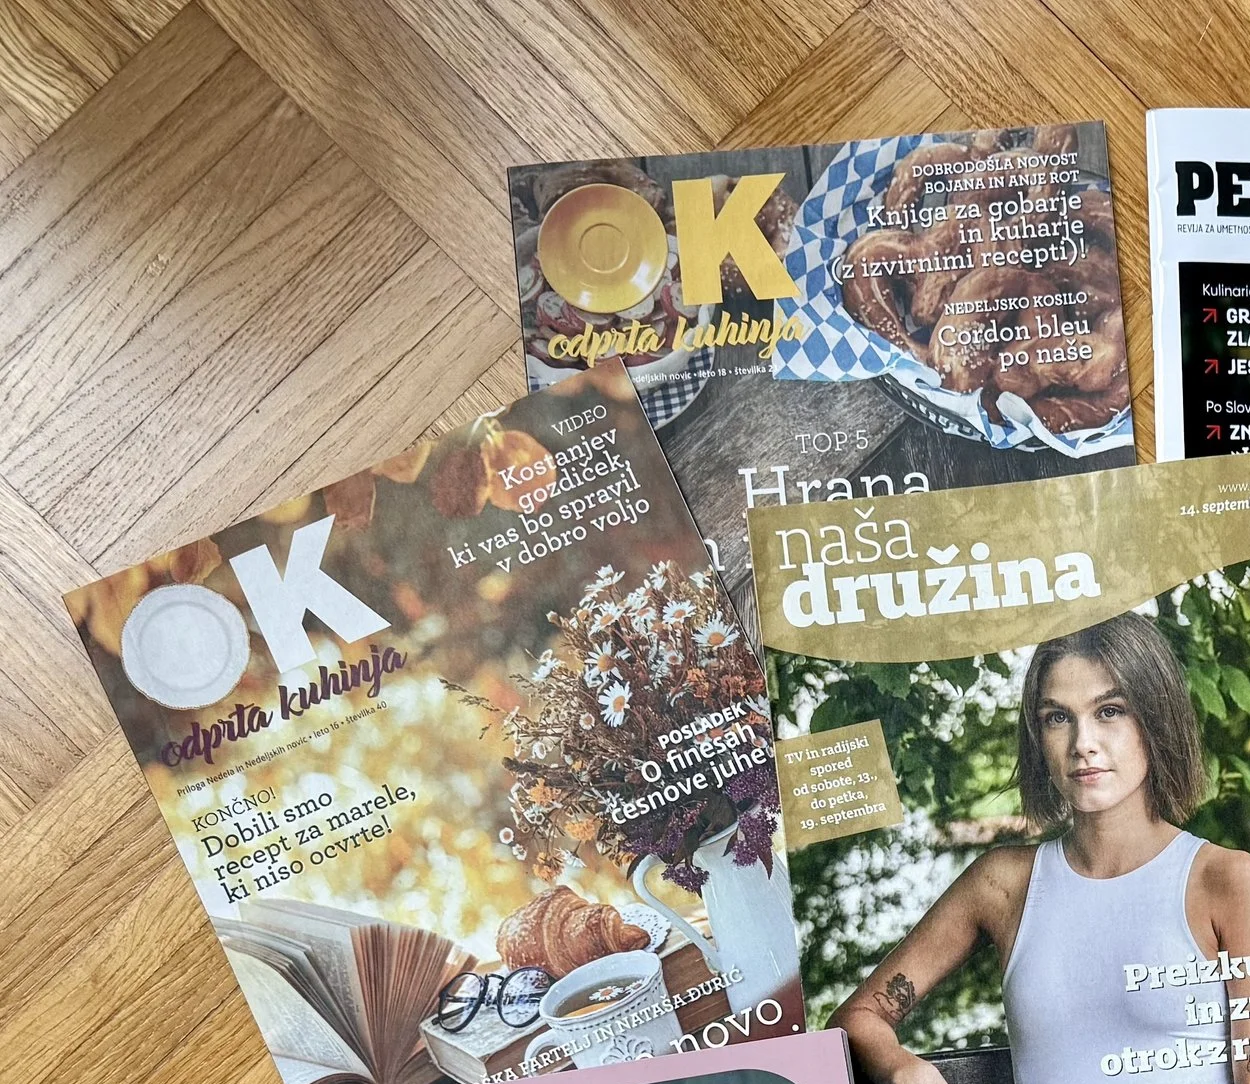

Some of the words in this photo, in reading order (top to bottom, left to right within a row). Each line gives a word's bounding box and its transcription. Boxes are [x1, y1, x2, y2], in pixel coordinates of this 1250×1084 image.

[913, 157, 1013, 177] DOBRODOŠLA
[1017, 153, 1078, 169] NOVOST
[925, 178, 986, 193] BOJANA
[989, 177, 1004, 187] IN
[1009, 174, 1046, 187] ANJE
[1050, 170, 1079, 183] ROT
[867, 203, 948, 229] Knjiga
[955, 203, 981, 219] za
[989, 192, 1082, 220] gobarje
[1178, 224, 1203, 233] REVIJA
[1206, 224, 1214, 233] ZA
[945, 298, 1029, 315] NEDELJSKO
[1033, 292, 1087, 306] KOSILO
[938, 320, 1030, 346] Cordon
[1037, 315, 1090, 337] bleu
[999, 348, 1029, 372] po
[1036, 339, 1092, 363] naše
[552, 405, 607, 437] VIDEO
[795, 432, 847, 454] TOP
[855, 430, 869, 448] 5
[499, 428, 619, 491] Kostanjev
[518, 455, 631, 513] gozdiček,
[1181, 504, 1199, 516] 14.
[774, 506, 918, 570] naša
[781, 542, 1102, 628] družina
[160, 702, 274, 767] odprta
[278, 645, 408, 720] kuhinja
[177, 782, 205, 796] Priloga
[287, 736, 308, 750] novic
[313, 728, 329, 738] leto
[330, 721, 339, 730] 16
[346, 707, 375, 725] številka
[377, 701, 387, 711] 40
[785, 751, 804, 764] TV
[806, 749, 819, 759] in
[821, 736, 869, 756] radijski
[810, 757, 853, 777] spored
[793, 784, 809, 796] od
[811, 777, 856, 793] sobote,
[811, 799, 826, 809] do
[828, 791, 868, 808] petka,
[191, 787, 277, 832] KONČNO!
[202, 813, 279, 858] Dobili
[284, 792, 332, 822] smo
[800, 819, 818, 829] 19.
[820, 802, 886, 824] septembra
